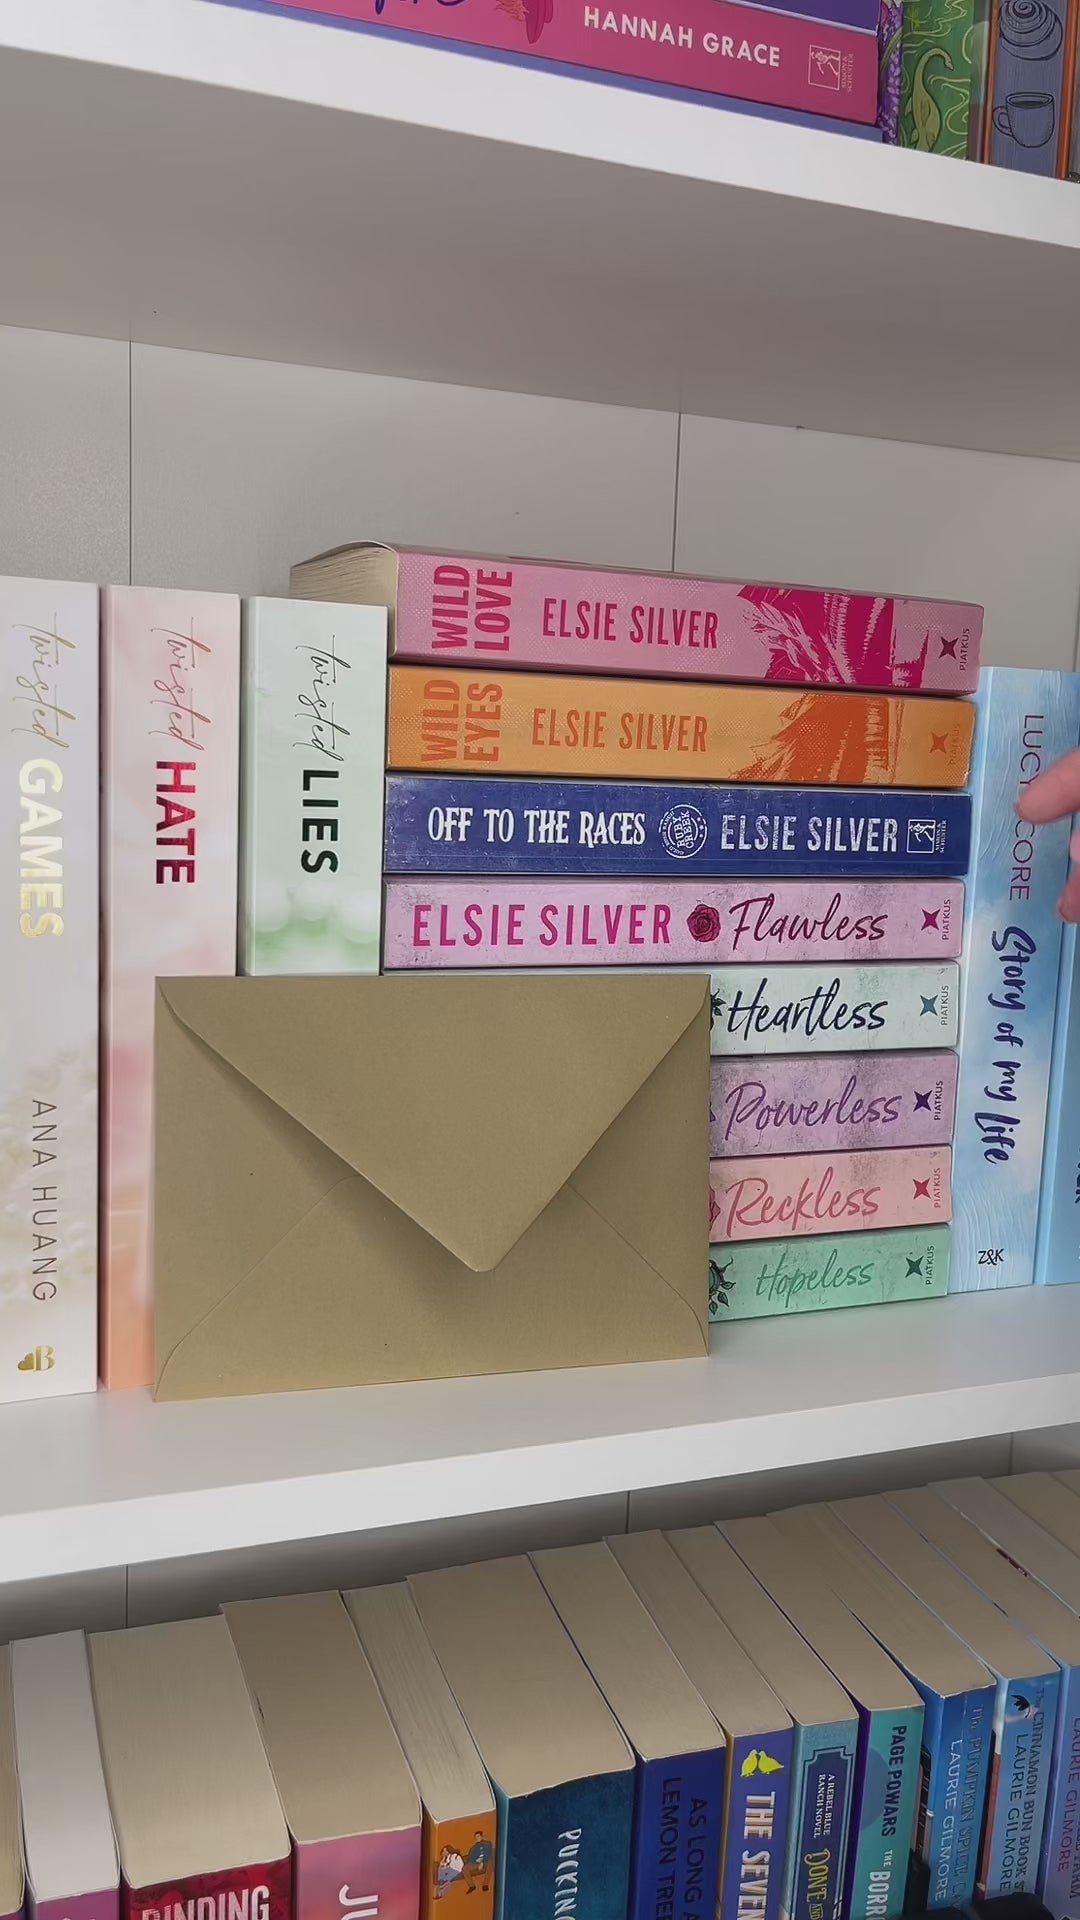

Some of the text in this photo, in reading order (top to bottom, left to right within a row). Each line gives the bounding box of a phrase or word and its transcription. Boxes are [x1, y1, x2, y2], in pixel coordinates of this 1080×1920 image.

[584, 6, 780, 67] HANNAH GRACE
[431, 564, 470, 649] WILD
[474, 568, 513, 651] LOVE
[542, 598, 719, 649] ELSIE SILVER
[959, 628, 970, 671] PIATKUS
[420, 679, 460, 762] WILD
[463, 683, 503, 762] EYES
[532, 708, 708, 752] ELSIE SILVER
[148, 617, 211, 884] twisted HATE
[293, 634, 351, 874] twisted LIES
[1020, 714, 1044, 785] LUCY
[19, 758, 65, 938] GAMES
[428, 806, 647, 849] OFF TO THE RACES
[672, 816, 686, 848] RUBY
[680, 810, 694, 849] CREEK
[721, 814, 898, 853] ELSIE SILVER
[413, 904, 671, 947] ELSIE SILVER
[728, 893, 888, 951] Flawless
[942, 899, 951, 940] PIATKUS
[988, 926, 1036, 1010] Story
[727, 977, 888, 1041] Heartless
[940, 984, 949, 1026] PIATKUS
[994, 1022, 1024, 1047] of
[933, 1080, 943, 1120] PIATKUS
[984, 1060, 1021, 1101] my
[724, 1076, 902, 1141] Powerless
[32, 1099, 57, 1301] ANA HUANG
[724, 1166, 881, 1238] Reckless
[933, 1167, 941, 1208] PIATKUS
[756, 1249, 875, 1307] Hopeless
[925, 1245, 935, 1285] PIATKUS
[978, 1249, 1004, 1265] Z&K
[889, 1726, 907, 1766] PAGE
[1025, 1711, 1045, 1796] CINNAMON
[813, 1774, 826, 1839] RANCH NOVEL
[825, 1782, 835, 1813] REBEL
[881, 1769, 903, 1837] POWARS
[960, 1738, 982, 1823] PUMPKIN
[1058, 1716, 1080, 1873] LAURIE GILMORE
[658, 1777, 681, 1865] LEMON
[688, 1798, 708, 1829] AS
[743, 1791, 776, 1840] THE
[823, 1813, 833, 1836] BLUE
[935, 1739, 963, 1901] LAURIE GILMORE
[999, 1733, 1028, 1892] LAURIE GILMORE
[1021, 1801, 1035, 1832] BUN
[683, 1836, 707, 1904] LONG
[804, 1848, 831, 1902] DONE
[883, 1849, 893, 1867] THE
[953, 1826, 973, 1878] SPICE
[1015, 1835, 1031, 1879] BOOK
